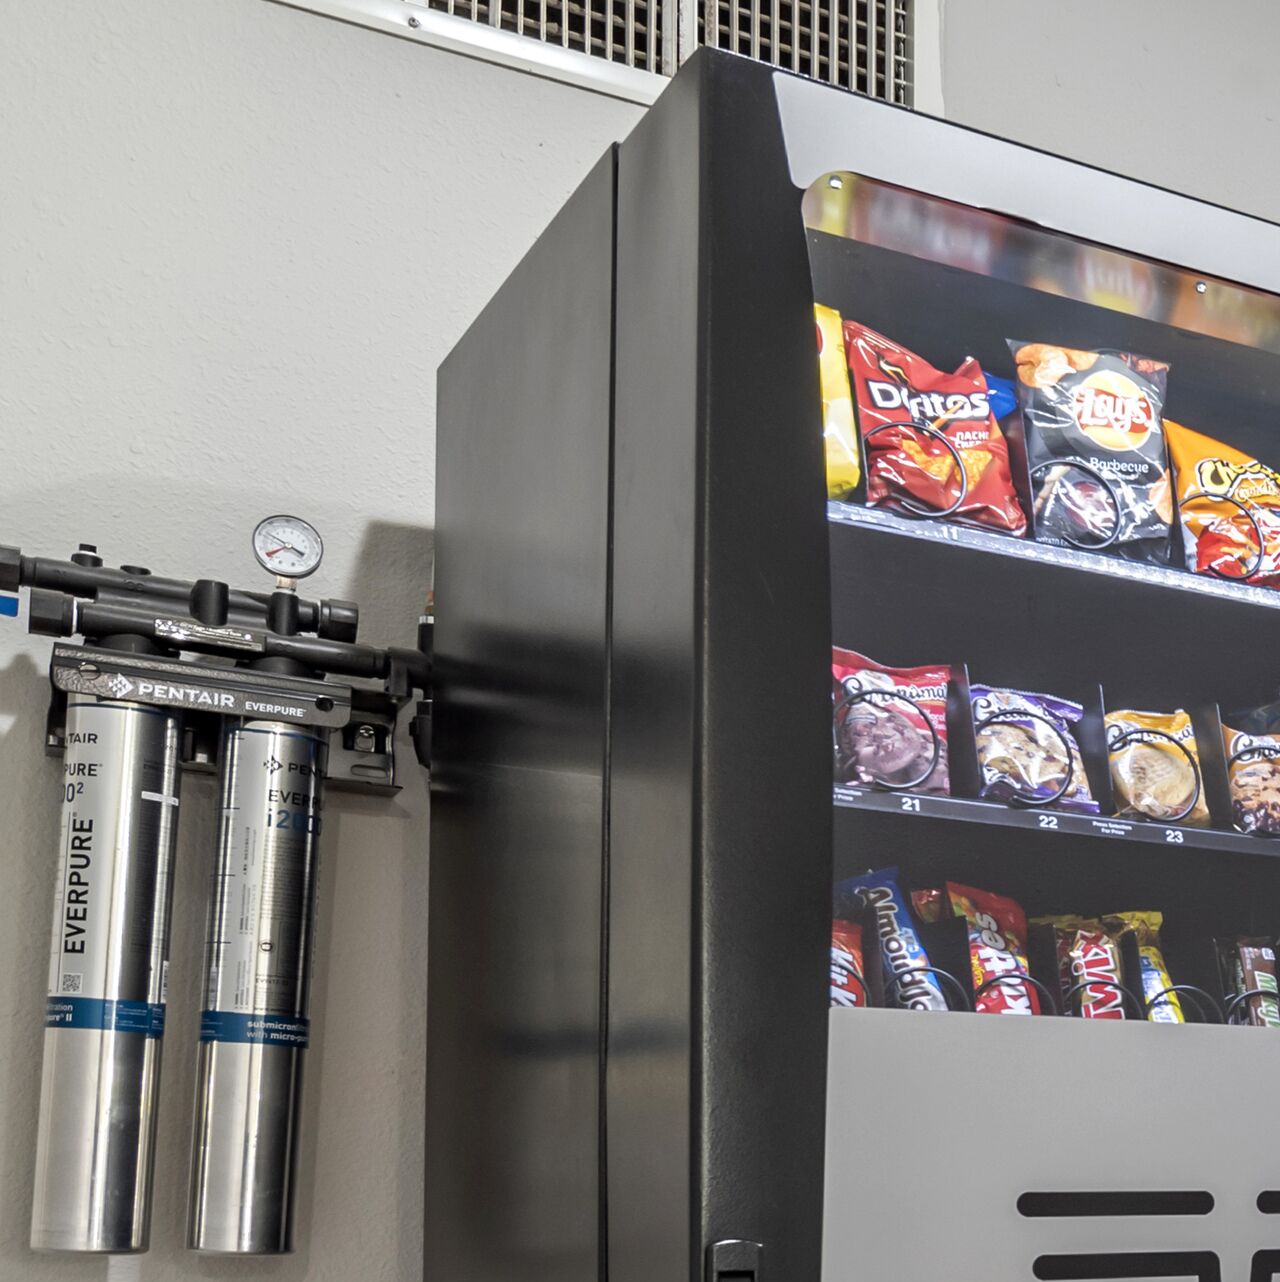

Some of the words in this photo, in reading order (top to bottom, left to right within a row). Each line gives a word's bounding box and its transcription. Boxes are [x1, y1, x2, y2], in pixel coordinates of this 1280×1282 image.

[1089, 456, 1149, 474] Barbecue
[138, 683, 235, 708] PENTAIR
[245, 701, 306, 718] EVERPURE
[902, 797, 920, 812] 21
[1039, 814, 1058, 829] 22
[1166, 829, 1184, 844] 23
[64, 817, 94, 954] EVERPURE
